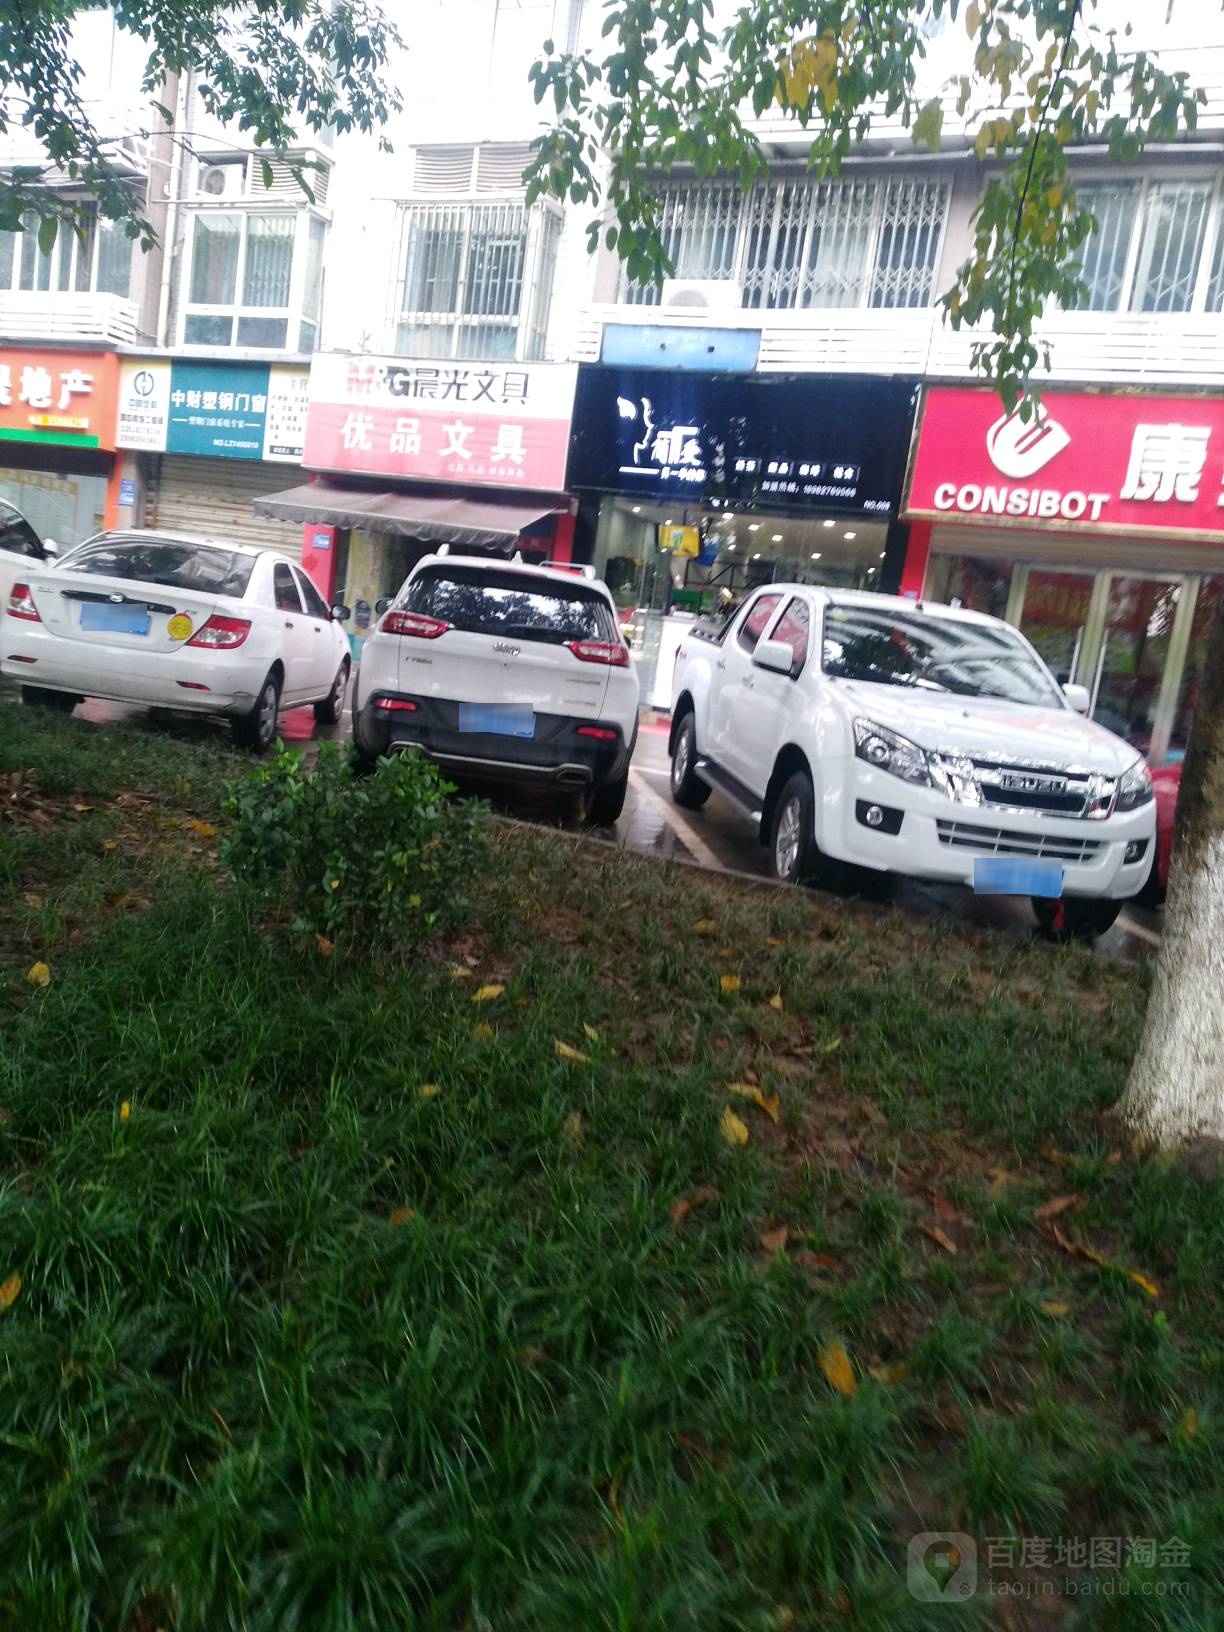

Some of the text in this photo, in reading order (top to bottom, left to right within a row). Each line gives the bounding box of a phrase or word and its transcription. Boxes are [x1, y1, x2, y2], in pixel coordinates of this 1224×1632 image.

[171, 389, 267, 414] 中财塑钢门窗
[340, 411, 528, 466] 优品文具
[932, 482, 1111, 521] CONSIBOT
